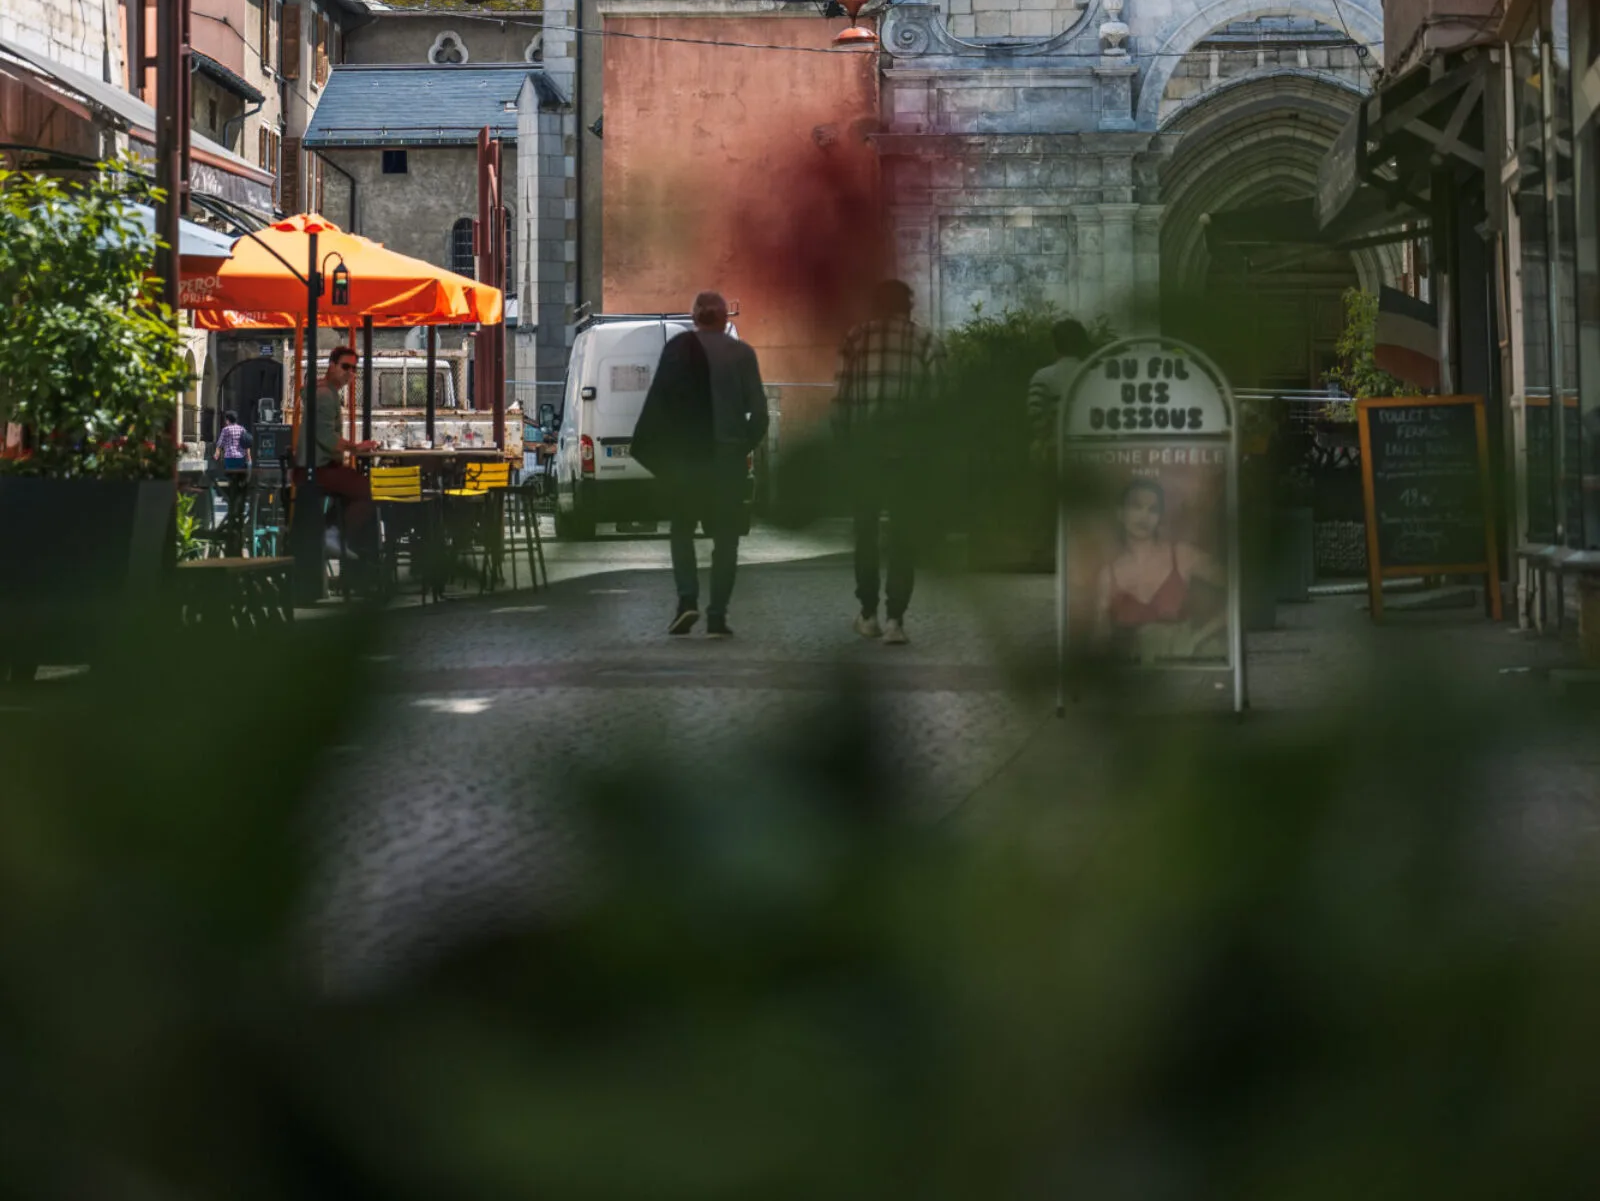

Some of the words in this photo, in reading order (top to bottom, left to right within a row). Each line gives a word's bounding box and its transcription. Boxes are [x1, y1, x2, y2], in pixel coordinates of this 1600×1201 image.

[178, 276, 224, 294] PEROL
[1106, 358, 1138, 380] AU
[1148, 356, 1190, 380] FIL
[1121, 382, 1170, 404] DES
[1090, 407, 1203, 430] DESSOUS
